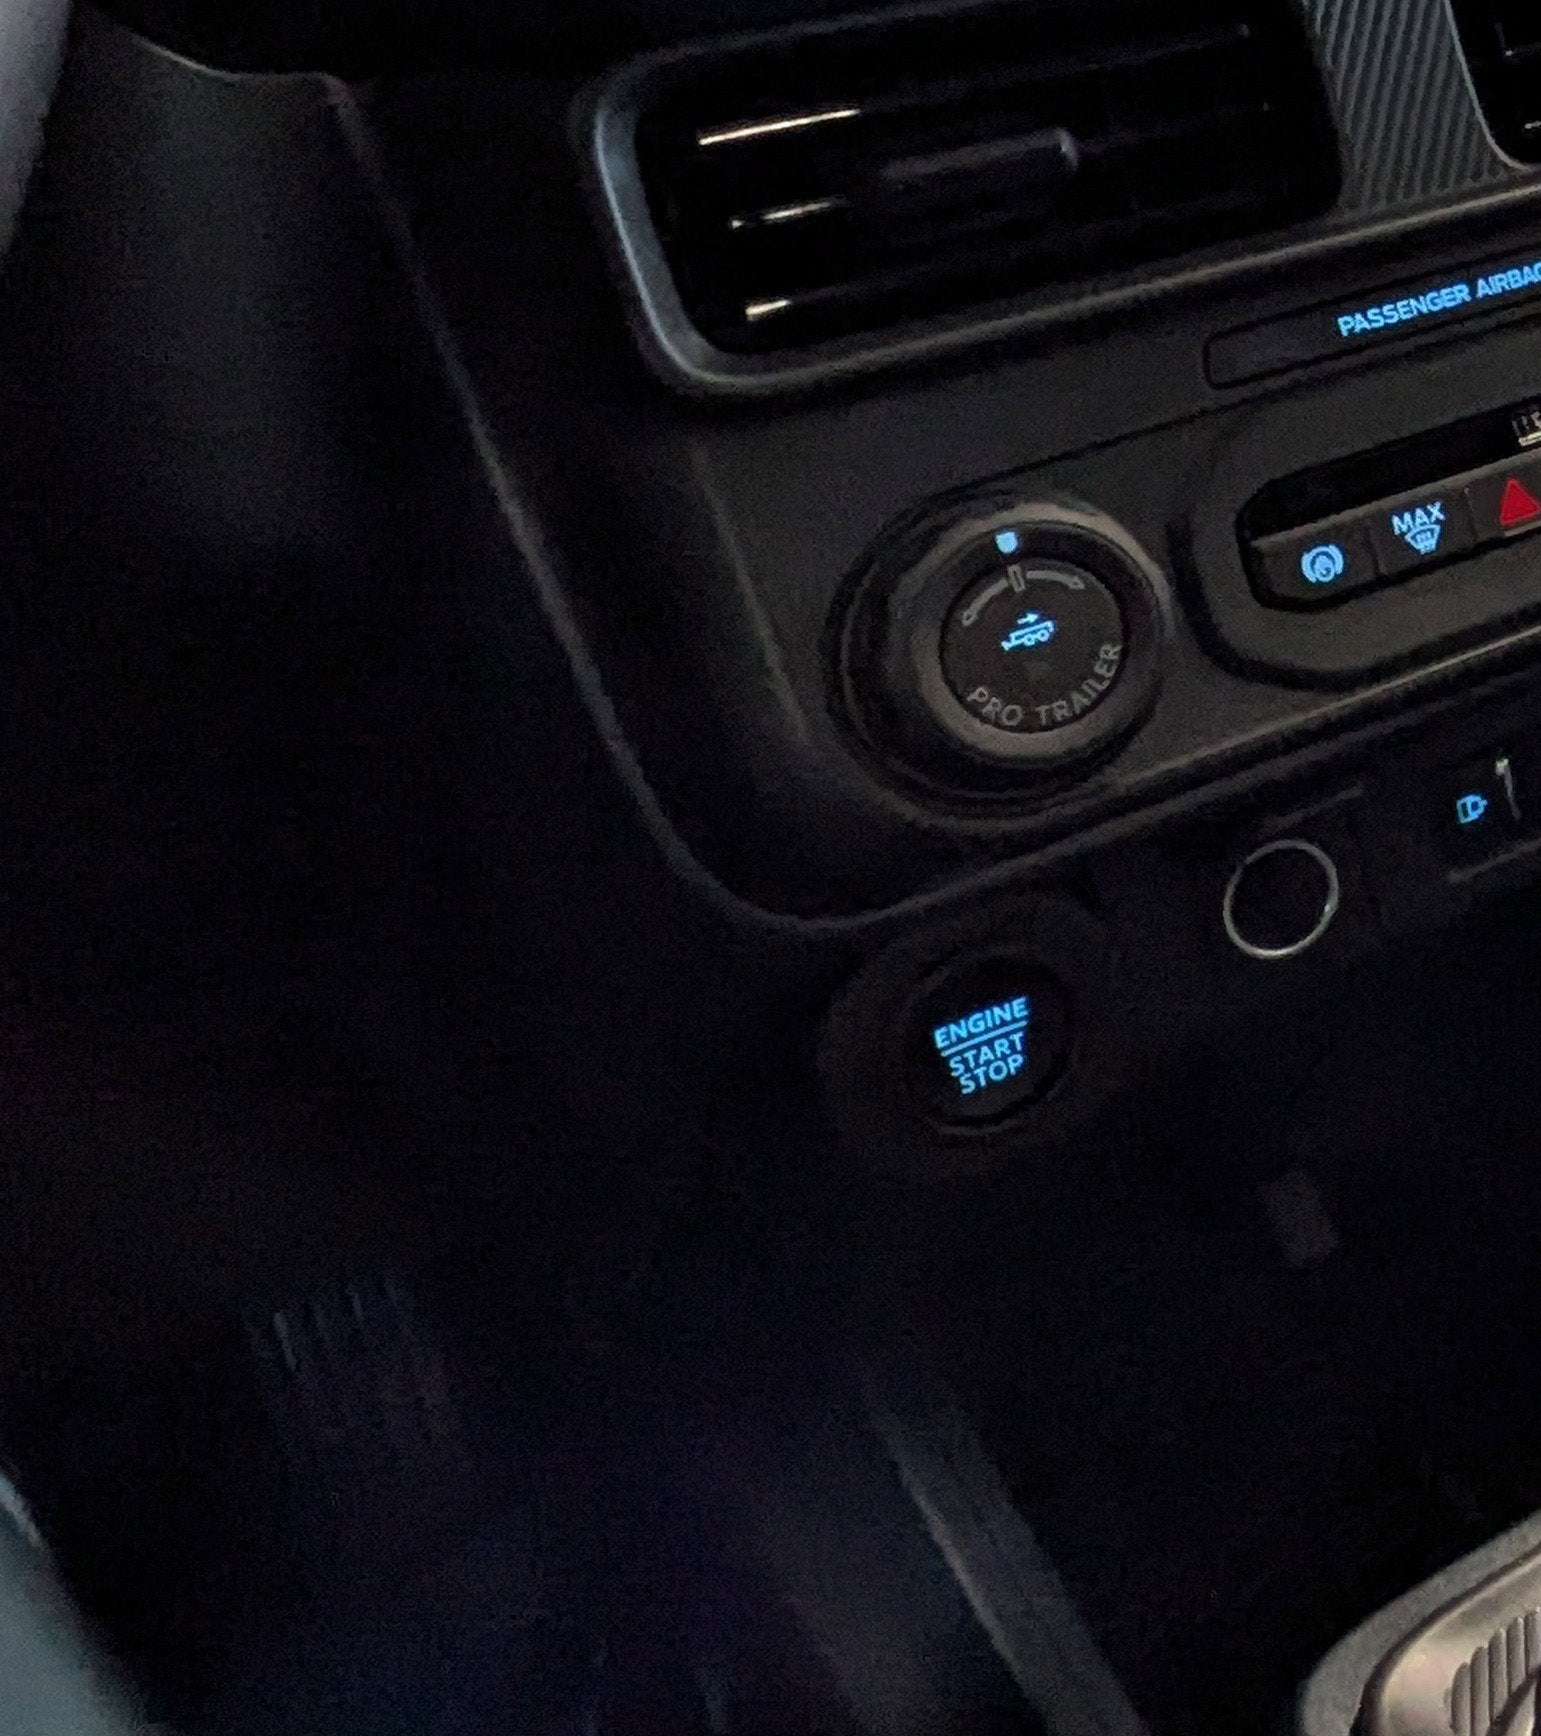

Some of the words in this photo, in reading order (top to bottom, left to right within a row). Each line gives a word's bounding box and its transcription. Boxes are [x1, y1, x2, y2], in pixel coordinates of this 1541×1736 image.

[1336, 283, 1471, 337] PASSENGER
[1392, 501, 1446, 535] MAX
[966, 686, 1023, 726] PRO
[1035, 644, 1122, 725] TRAILER
[934, 996, 1029, 1049] ENGINE
[949, 1031, 1024, 1077] START
[959, 1053, 1024, 1095] STOP
